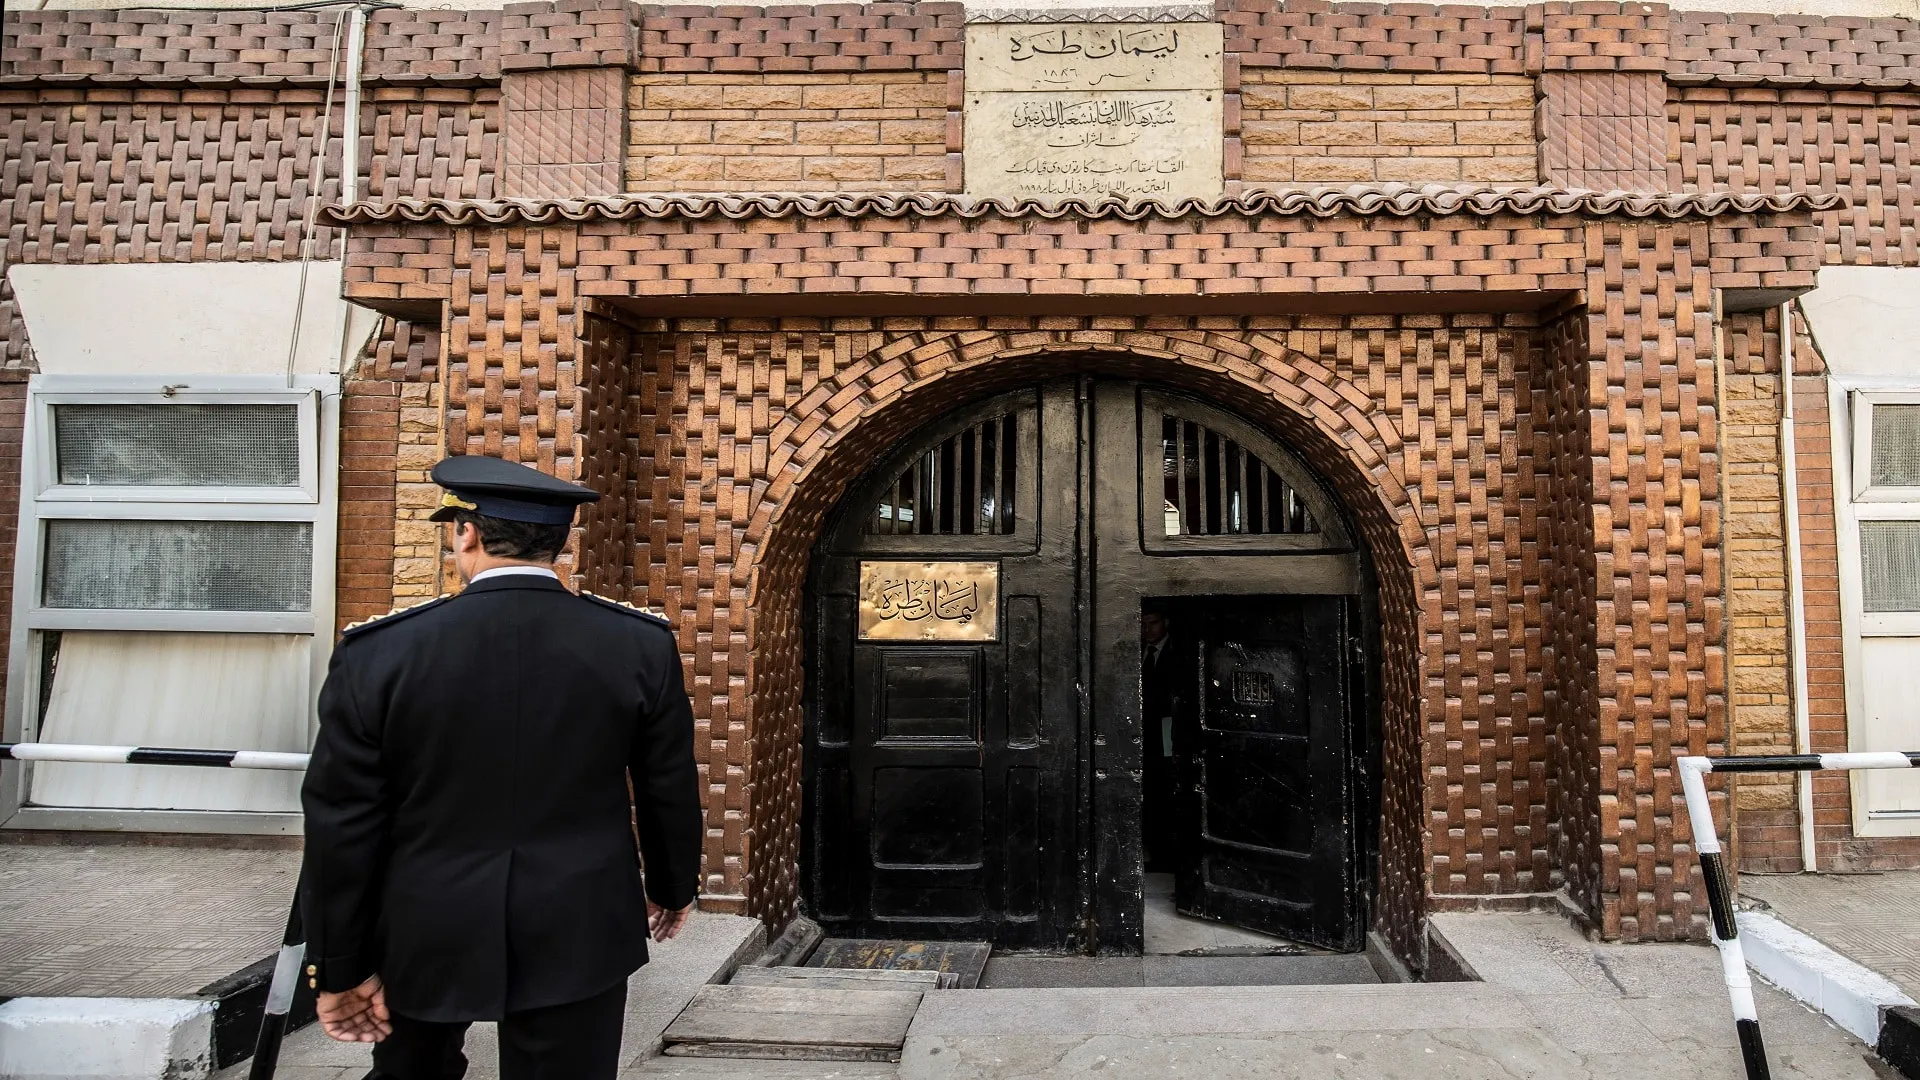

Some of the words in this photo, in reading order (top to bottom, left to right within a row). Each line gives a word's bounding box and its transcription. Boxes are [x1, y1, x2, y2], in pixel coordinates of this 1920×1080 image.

[1010, 30, 1083, 61] طره
[1085, 29, 1178, 58] ليمان
[1094, 132, 1141, 148] تحت
[1097, 179, 1125, 194] الليان
[880, 578, 923, 621] طره
[902, 579, 978, 624] ليمان
